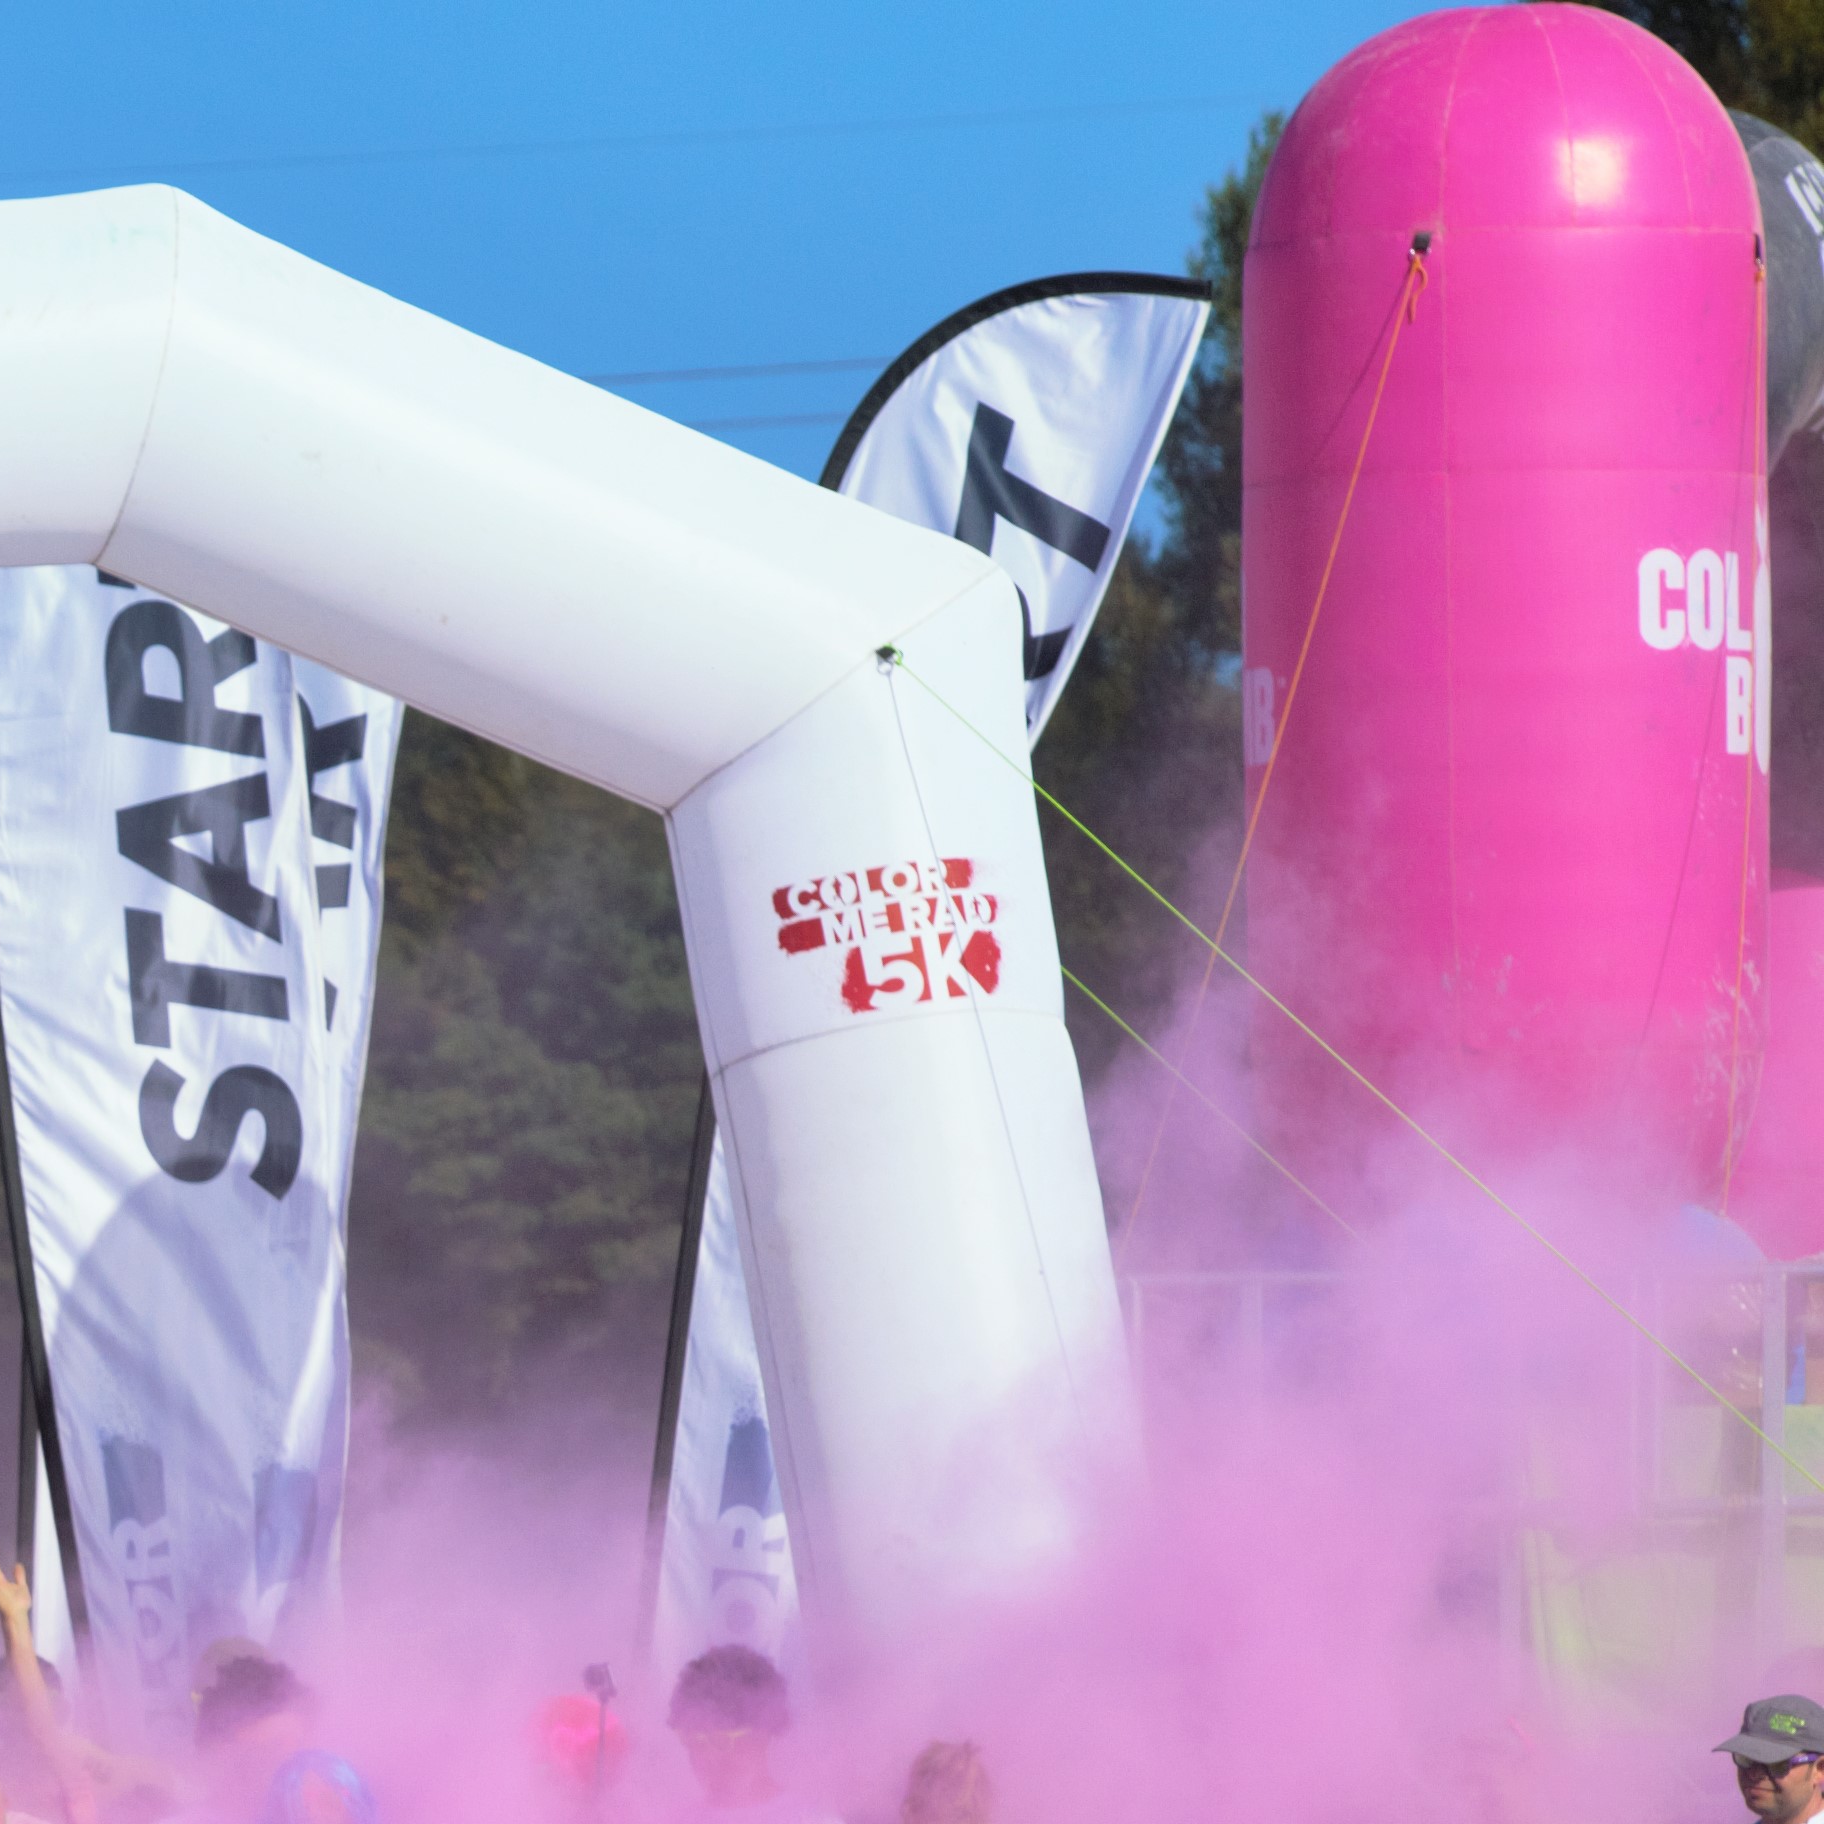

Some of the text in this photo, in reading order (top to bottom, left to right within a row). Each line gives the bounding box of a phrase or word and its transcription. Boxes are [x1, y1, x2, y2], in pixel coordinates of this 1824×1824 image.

[99, 566, 303, 1201] STAR
[787, 858, 949, 912] COLOR
[820, 893, 994, 947] ME RAD
[859, 930, 992, 1010] 5K
